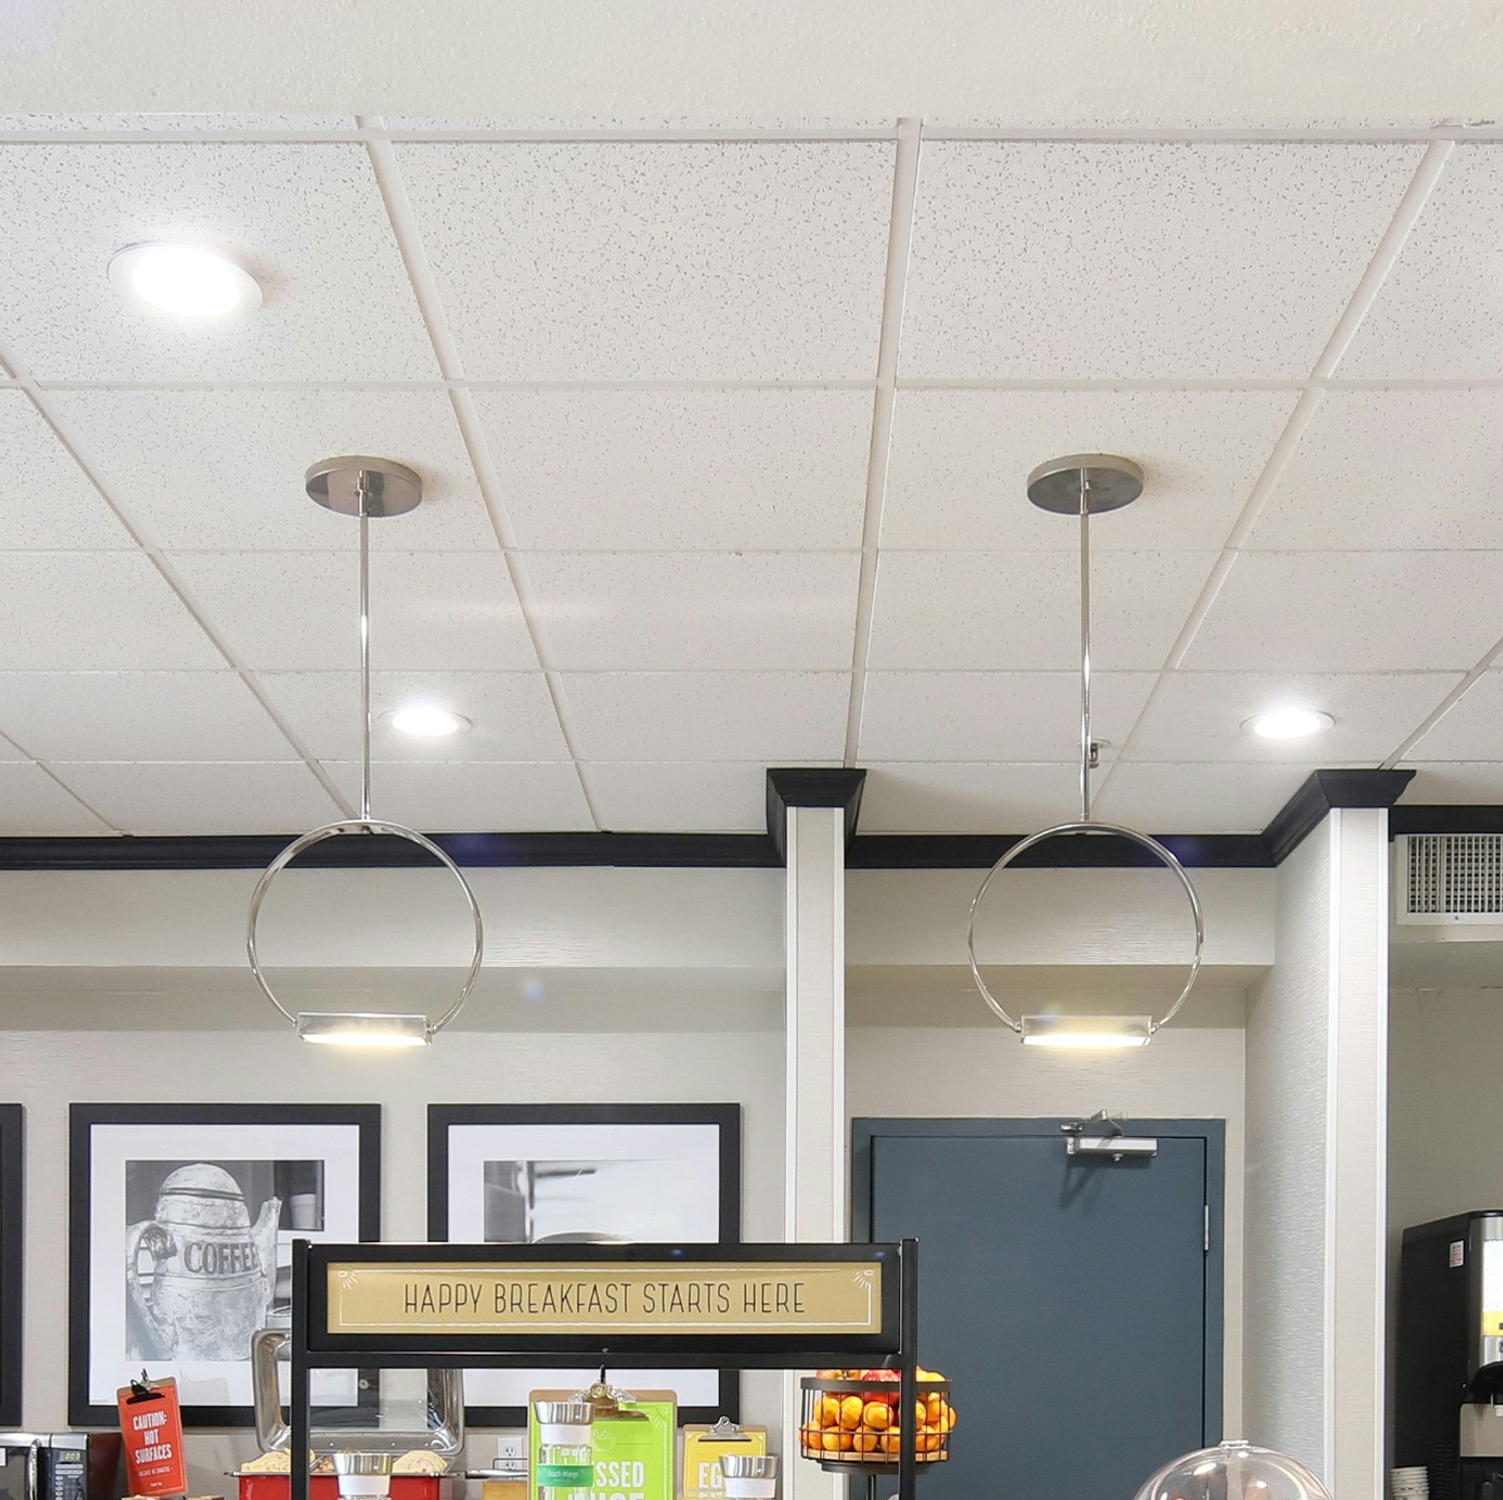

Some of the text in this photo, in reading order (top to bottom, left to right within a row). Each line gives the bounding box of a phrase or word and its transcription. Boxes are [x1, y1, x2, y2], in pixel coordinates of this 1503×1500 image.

[404, 1283, 805, 1314] HAPPY BREAKFAST STARTS HERE
[133, 1411, 167, 1431] CAUTION:
[144, 1429, 159, 1446] HOT
[135, 1444, 172, 1464] SURFACES
[595, 1461, 645, 1488] SSED
[699, 1462, 723, 1489] EG
